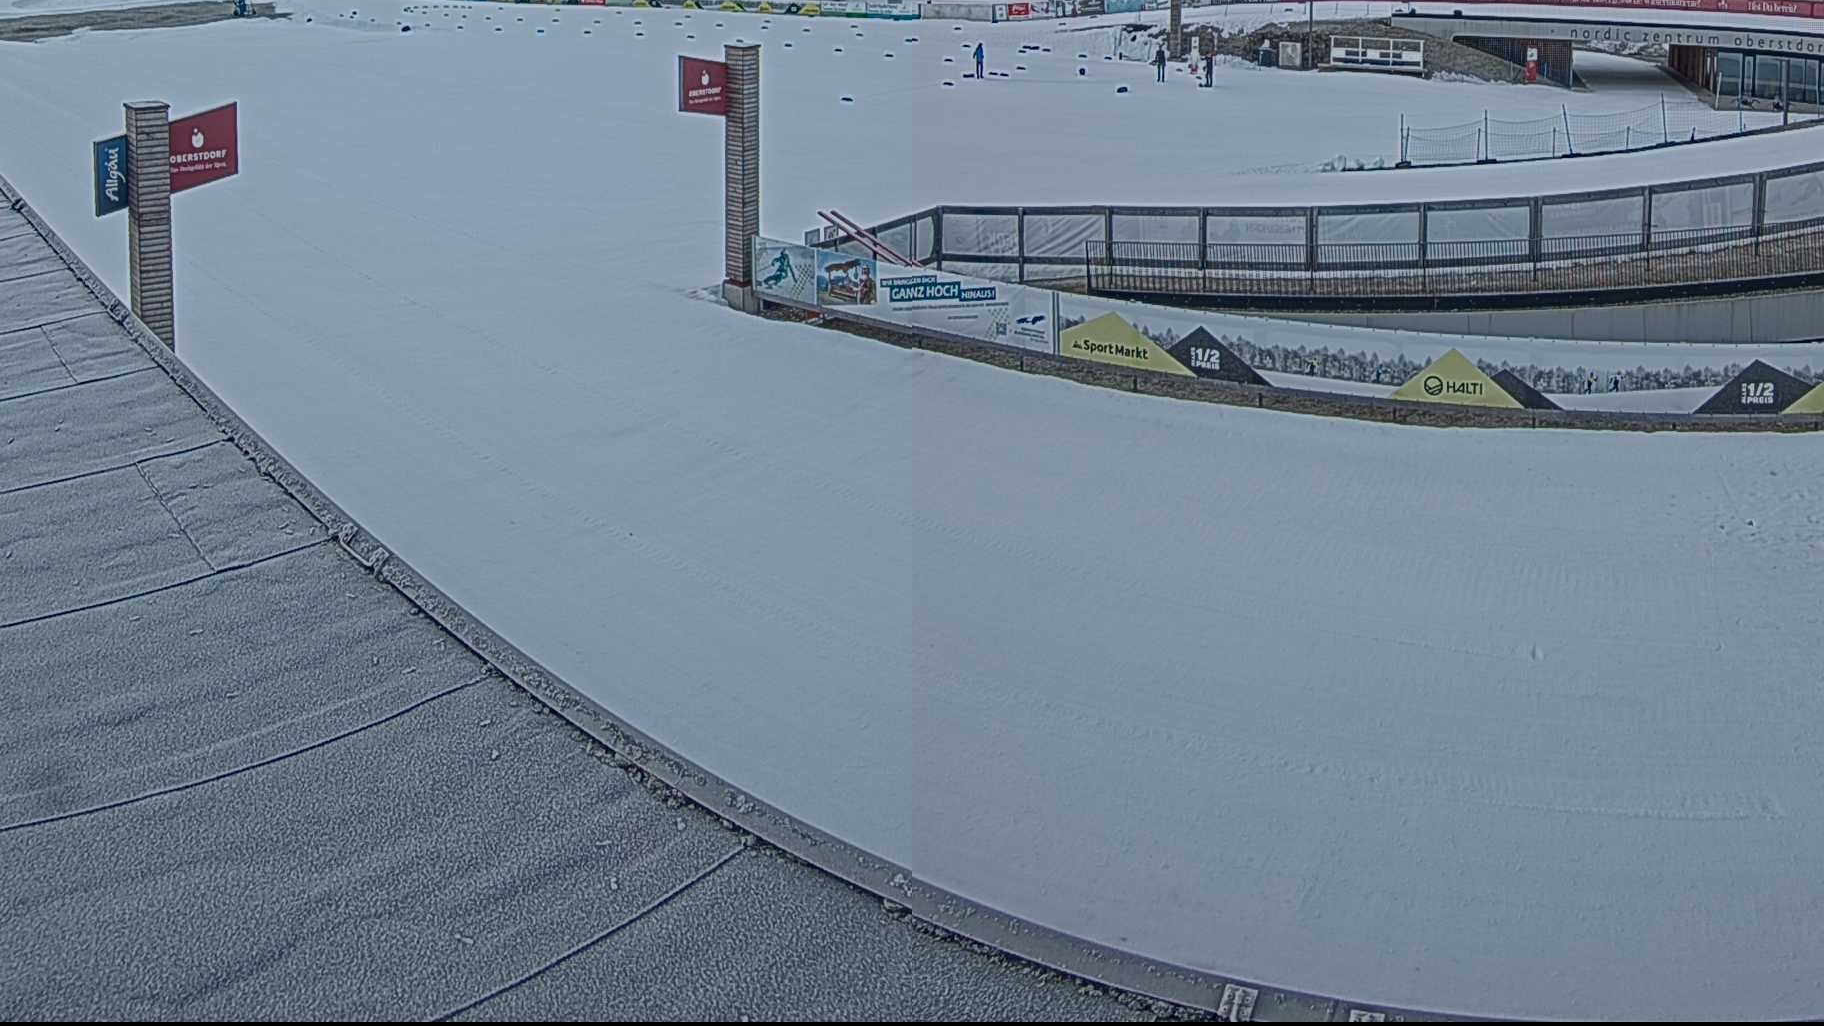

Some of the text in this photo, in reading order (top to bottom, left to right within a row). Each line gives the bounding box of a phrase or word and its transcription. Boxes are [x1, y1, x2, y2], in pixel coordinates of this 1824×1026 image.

[1570, 27, 1631, 41] nordic
[1643, 32, 1720, 45] zentrum
[169, 149, 228, 164] OBERSTDORF
[104, 147, 127, 202] Allgäu
[926, 284, 959, 298] HOCH
[1083, 339, 1149, 360] Sport Markt
[1196, 347, 1220, 363] 1/2
[1446, 380, 1484, 396] HALTI
[1747, 382, 1774, 396] 1/2
